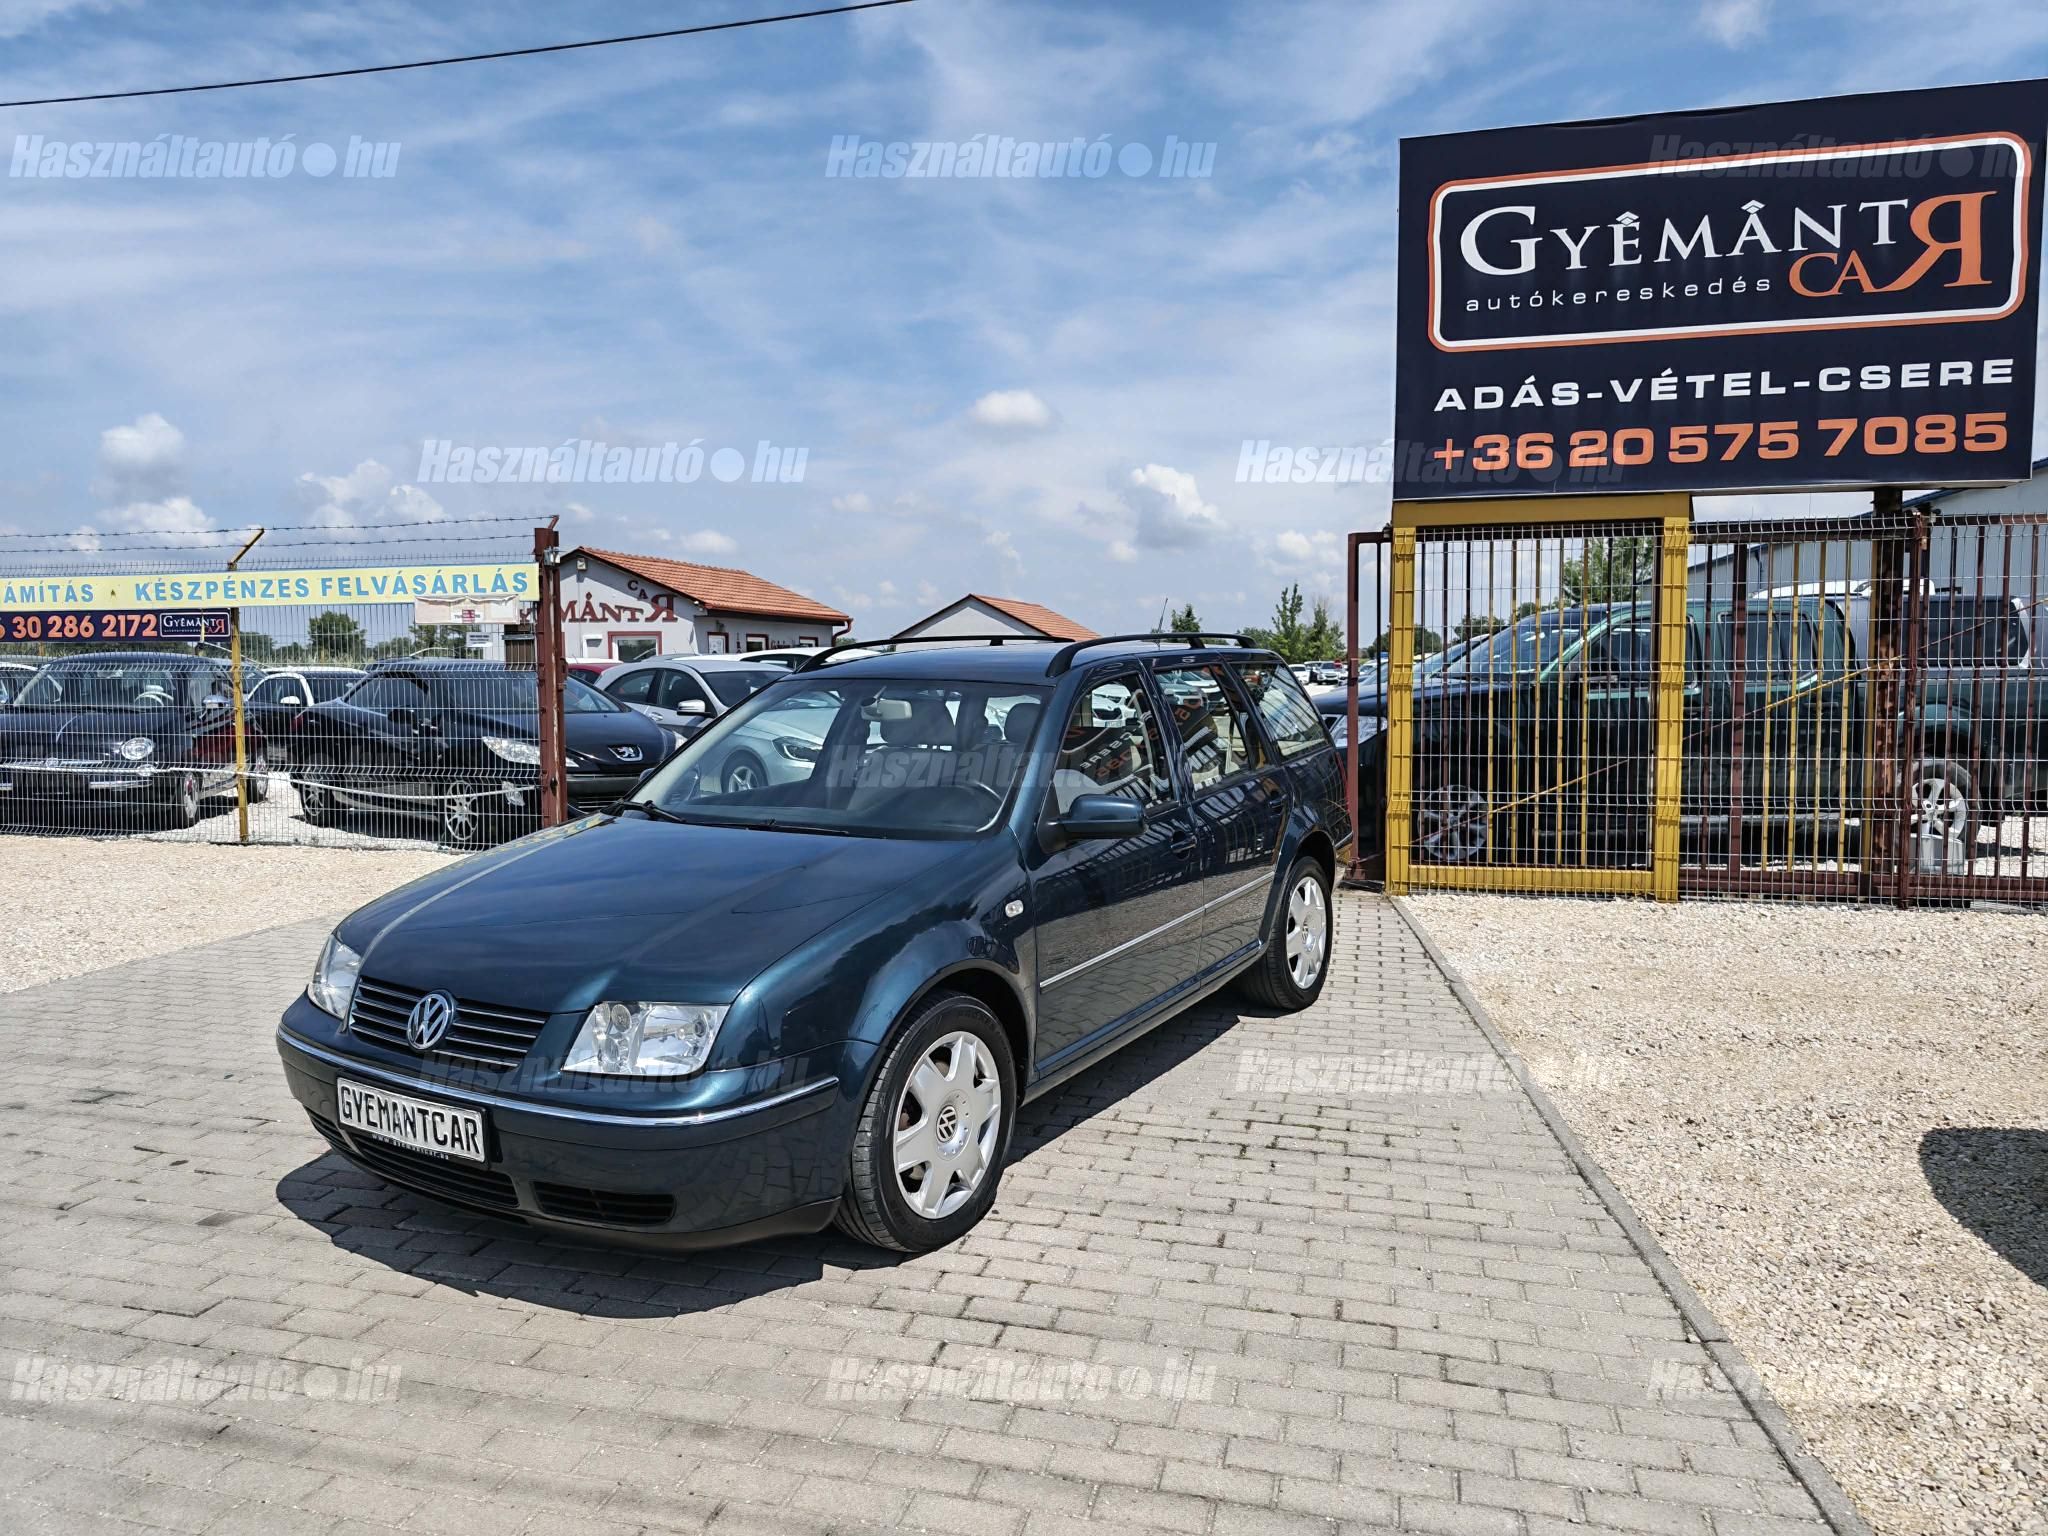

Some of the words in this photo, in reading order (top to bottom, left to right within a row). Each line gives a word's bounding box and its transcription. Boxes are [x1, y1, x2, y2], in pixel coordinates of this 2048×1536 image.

[1465, 275, 1771, 312] autókereskedés
[1433, 359, 2015, 413] ADÁS-VÉTEL-CSERE
[1433, 432, 1555, 472] +36
[1568, 428, 1655, 468] 20
[1668, 421, 1800, 464] 575
[1817, 412, 2009, 458] 7085
[135, 576, 310, 601] KÉSZPÉNZES
[320, 568, 528, 597] FELVÁSÁRLÁS
[12, 616, 42, 639] 30
[47, 615, 95, 639] 286
[101, 613, 158, 638] 2172
[341, 1086, 480, 1154] GYEMANTCAR
